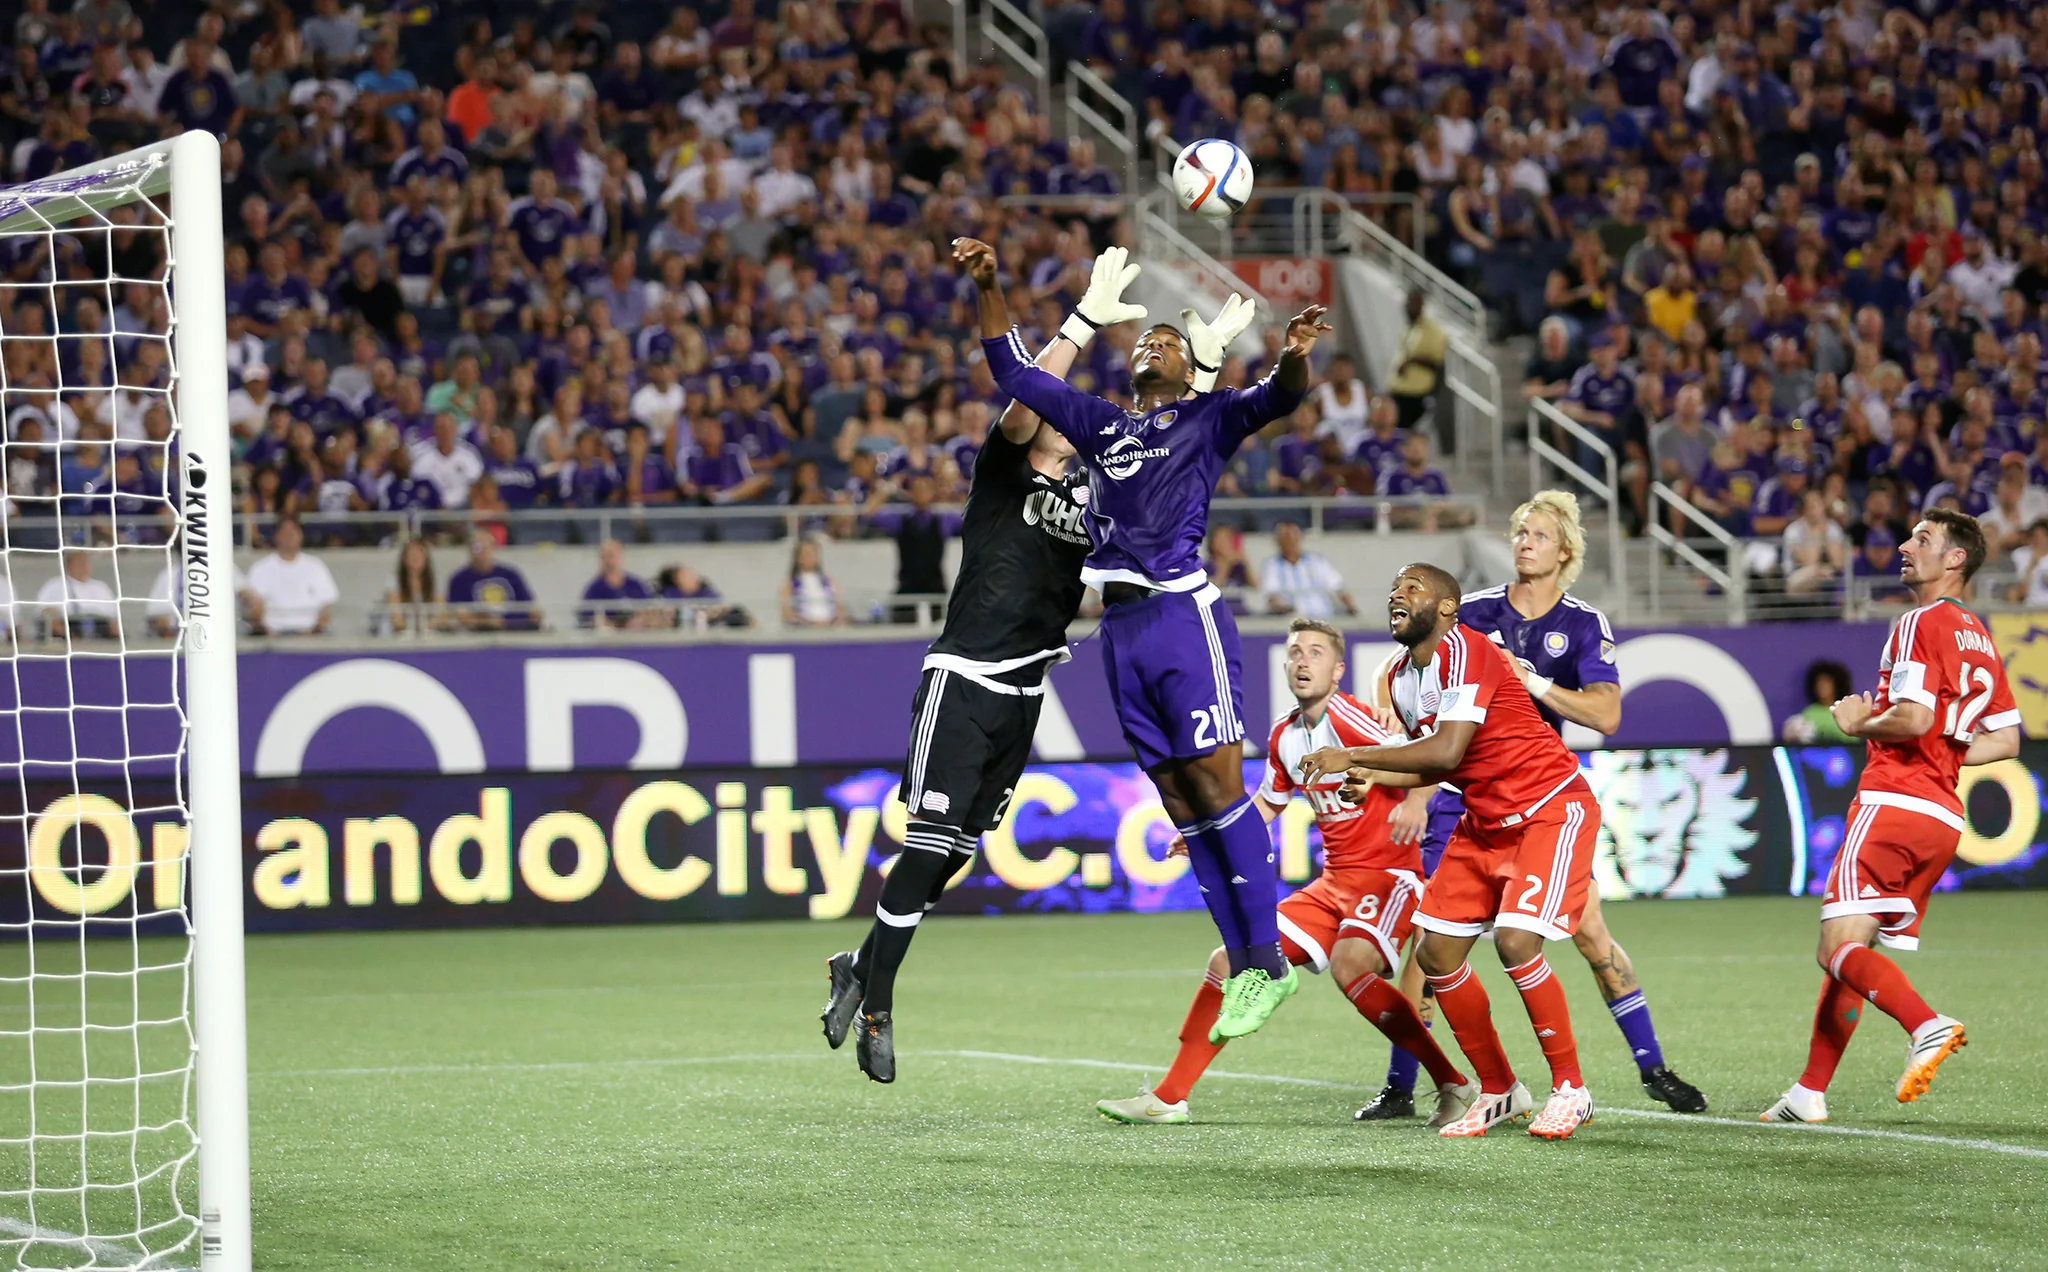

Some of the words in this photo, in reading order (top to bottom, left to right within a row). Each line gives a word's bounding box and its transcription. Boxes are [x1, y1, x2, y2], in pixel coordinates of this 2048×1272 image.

[1260, 259, 1323, 297] 106
[1129, 447, 1170, 460] HEALTH
[1954, 628, 1996, 661] DORMAN
[1943, 661, 1994, 742] 12
[1190, 704, 1222, 750] 21
[992, 787, 1014, 823] 2
[1354, 894, 1379, 920] 8
[1516, 874, 1543, 912] 2
